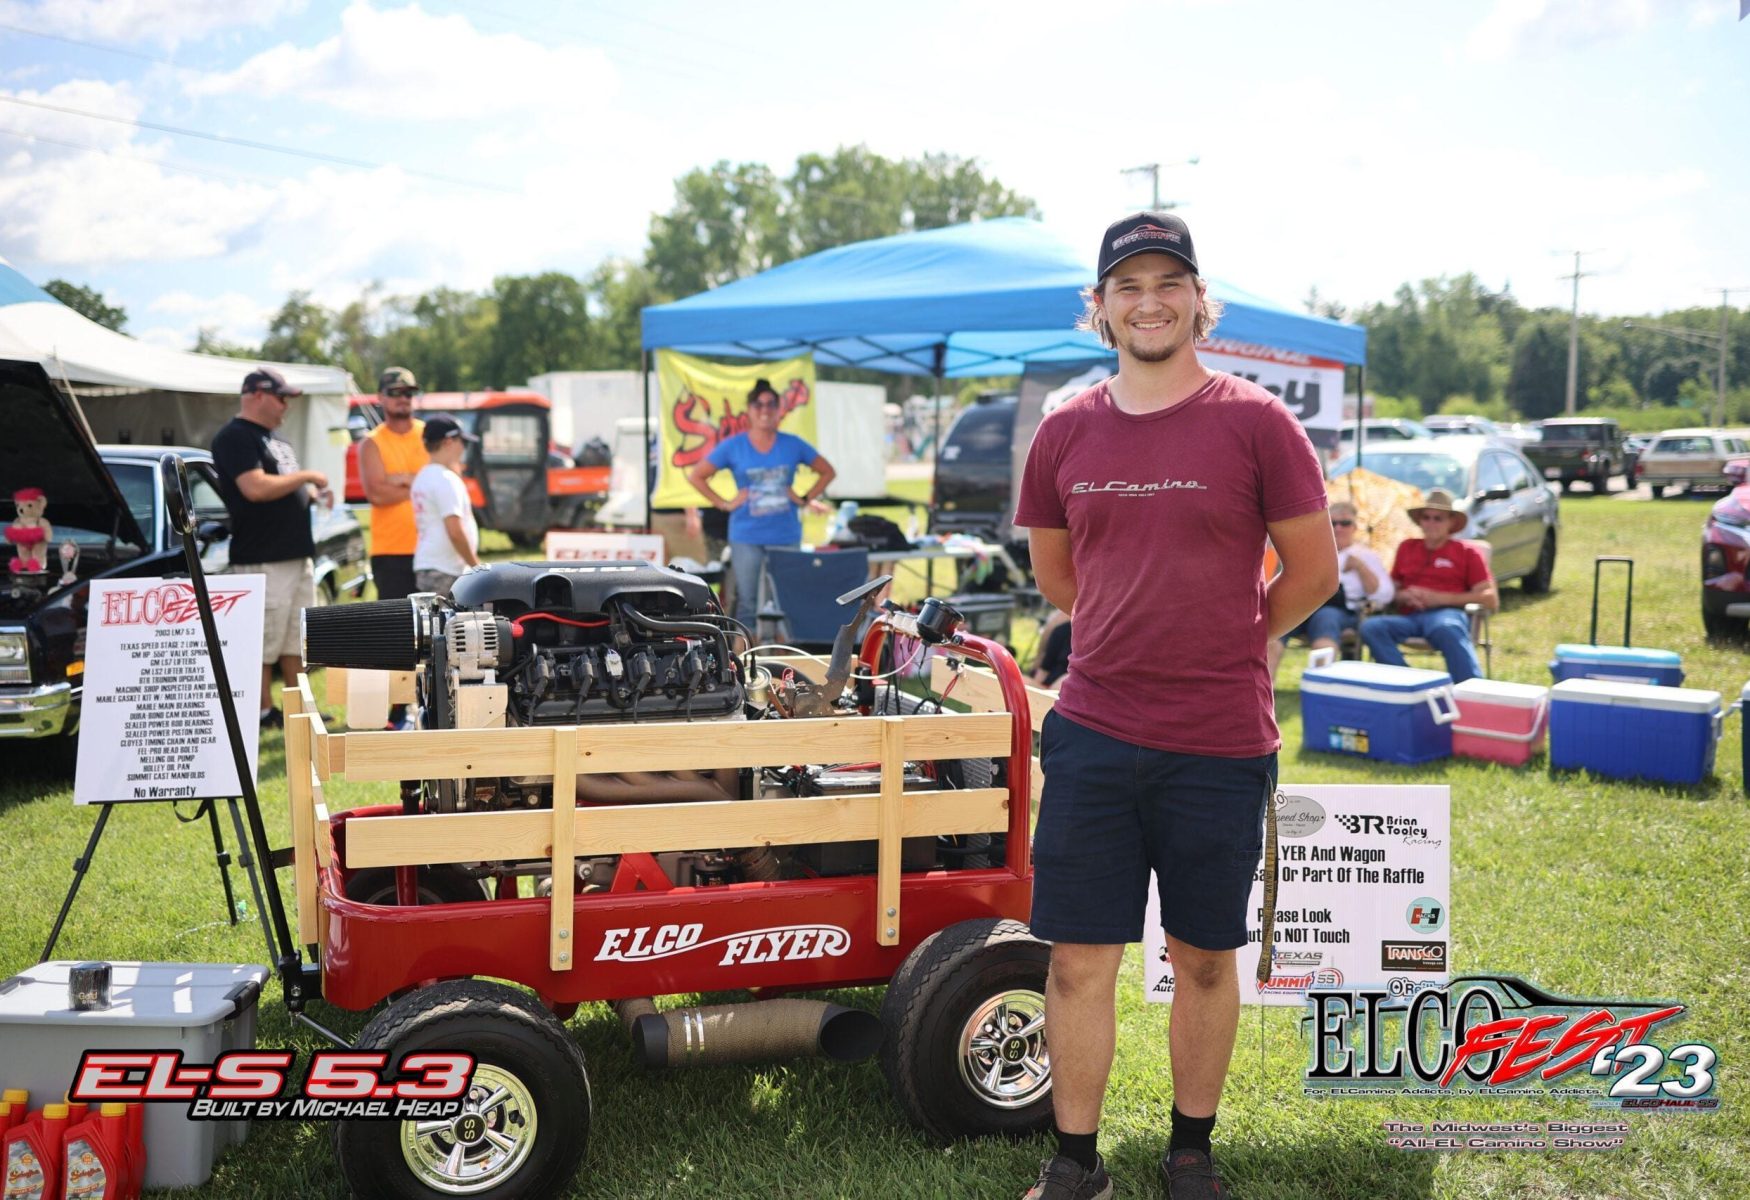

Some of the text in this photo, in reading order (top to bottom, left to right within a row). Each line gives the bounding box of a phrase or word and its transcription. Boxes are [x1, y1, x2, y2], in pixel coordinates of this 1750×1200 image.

[101, 587, 180, 626] ELCO
[155, 629, 171, 637] 2003
[120, 642, 139, 651] TEXAS
[141, 642, 159, 650] SPEED
[160, 641, 179, 650] STAGE
[185, 666, 205, 674] TRAYS
[115, 685, 142, 694] MACHINE
[144, 685, 159, 693] SHOP
[161, 683, 193, 692] INSPECTED
[194, 683, 208, 691] AND
[118, 694, 140, 702] GASKET
[158, 702, 175, 710] MAIN
[176, 701, 205, 710] BEARINGS
[166, 711, 180, 719] CAM
[181, 710, 210, 718] BEARINGS
[124, 721, 147, 730] SEALED
[148, 720, 170, 729] POWER
[184, 718, 214, 727] BEARINGS
[125, 727, 212, 739] SEALED POWER PISTON RINGS
[145, 738, 166, 747] TIMING
[167, 737, 185, 746] CHAIN
[201, 736, 216, 744] GEAR
[163, 746, 179, 754] HEAD
[180, 745, 199, 753] BOLTS
[140, 755, 165, 764] MELLING
[177, 754, 195, 763] PUMP
[143, 763, 165, 772] HOLLEY
[177, 762, 190, 771] PAN
[127, 771, 205, 782] SUMMIT CAST MANIFOLDS
[134, 785, 197, 798] No Warranty
[1273, 812, 1320, 824] peed Shop
[1348, 814, 1385, 834] BTR
[1386, 815, 1417, 826] Brian
[1386, 826, 1427, 839] Tooley
[1402, 835, 1442, 849] Racing
[1278, 845, 1385, 864] YER And Wagon
[1282, 866, 1298, 882] Or
[1302, 867, 1333, 883] Part
[1337, 867, 1352, 883] Of
[1356, 867, 1379, 883] The
[1383, 868, 1425, 884] Raffle
[1257, 908, 1332, 923] Pase Look
[1248, 928, 1262, 943] ut
[1285, 928, 1309, 943] NOT
[1313, 928, 1350, 943] Touch
[593, 923, 851, 966] ELCO FLYER
[1276, 952, 1323, 960] TEXAS
[1010, 1040, 1020, 1059] SS
[464, 1118, 476, 1140] SS
